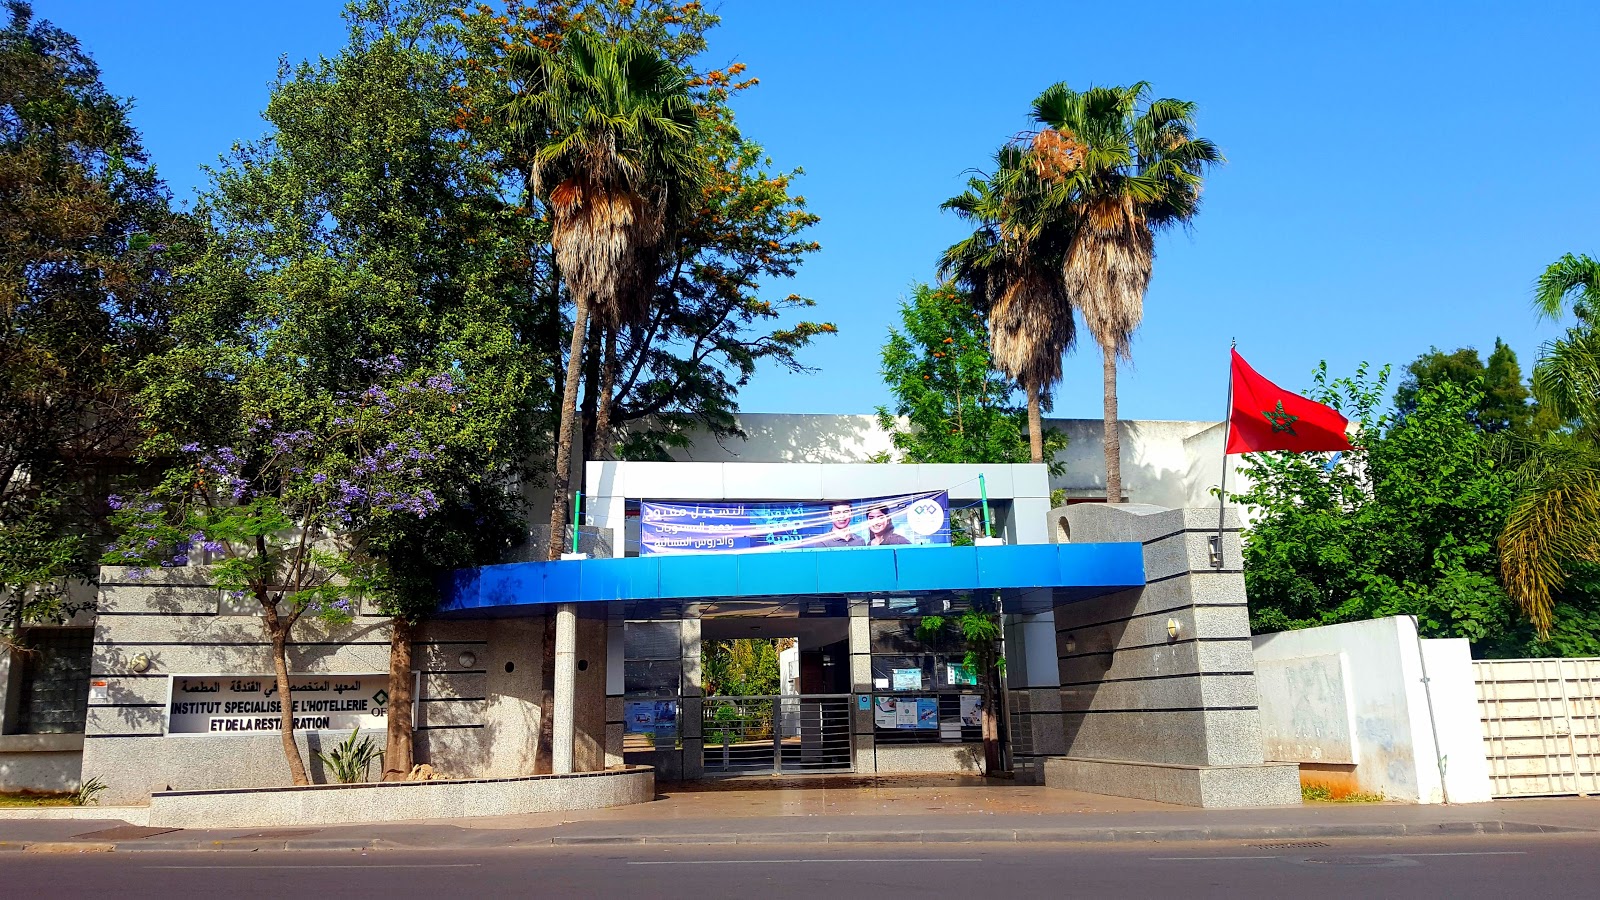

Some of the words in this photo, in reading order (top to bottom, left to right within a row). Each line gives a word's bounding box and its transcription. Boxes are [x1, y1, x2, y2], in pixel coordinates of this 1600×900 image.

[691, 505, 744, 519] التسجيل
[695, 536, 734, 549] والدروس
[181, 680, 220, 693] المطعمة
[229, 680, 261, 693] الفندقة
[263, 679, 279, 698] في
[333, 681, 361, 695] المعهد
[171, 701, 221, 714] INSTITUT
[224, 700, 282, 714] SPECIALISE
[301, 700, 368, 712] L'HOTELLERIE
[371, 707, 388, 717] OF
[210, 719, 225, 731] ET
[225, 719, 239, 731] DE
[239, 718, 253, 731] LA
[254, 717, 330, 731] RESTRATION
